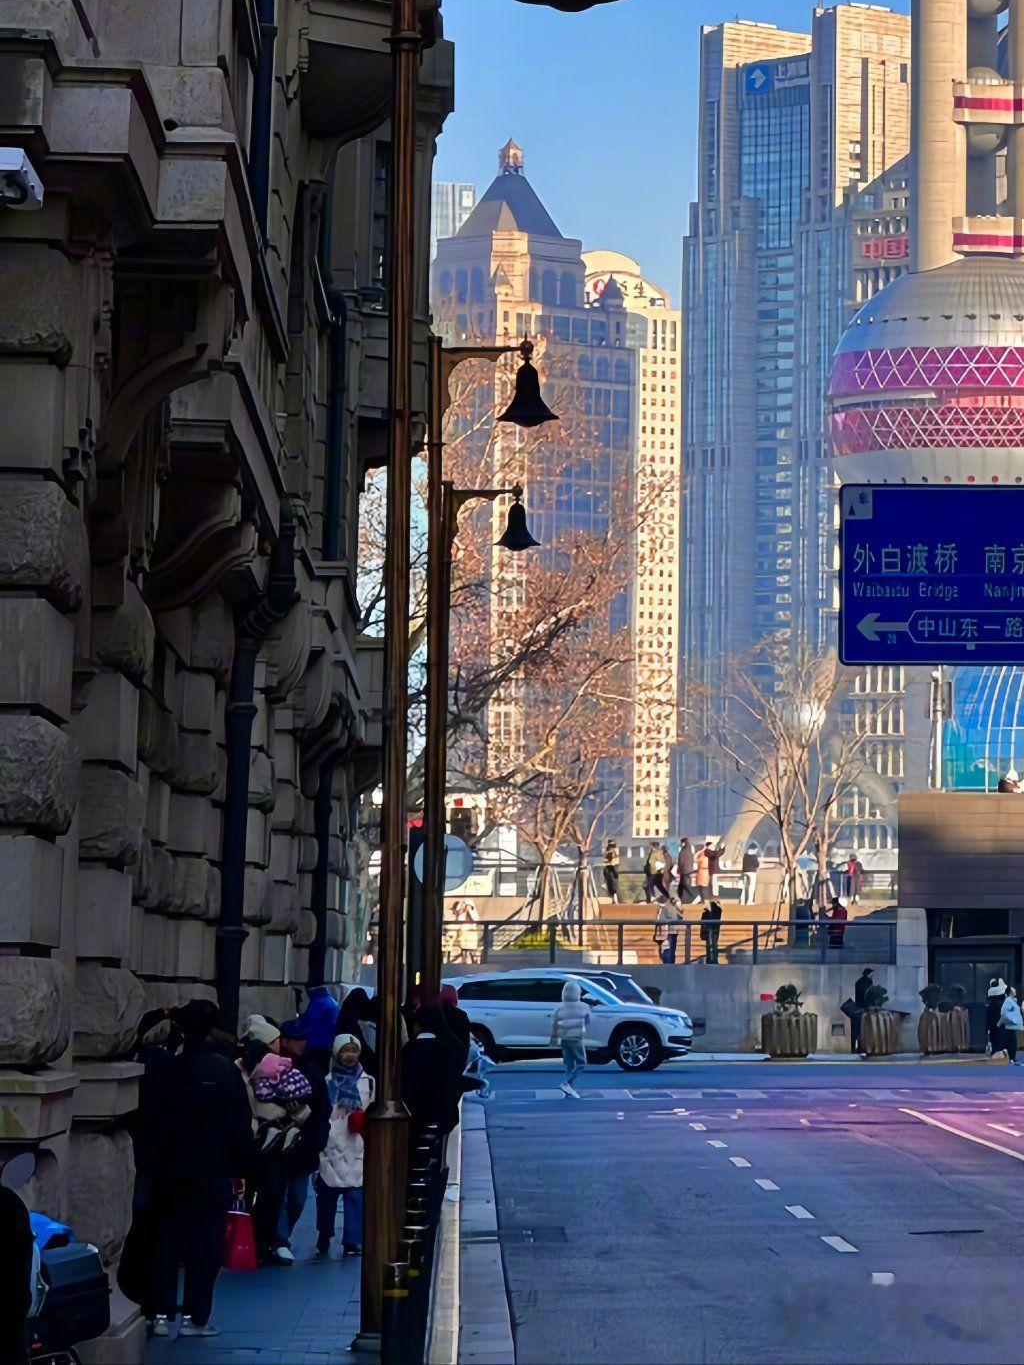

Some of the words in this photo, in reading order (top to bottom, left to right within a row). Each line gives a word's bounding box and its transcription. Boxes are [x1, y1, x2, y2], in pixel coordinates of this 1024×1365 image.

[853, 543, 958, 574] 外白渡桥
[917, 615, 1023, 638] 中山东一路
